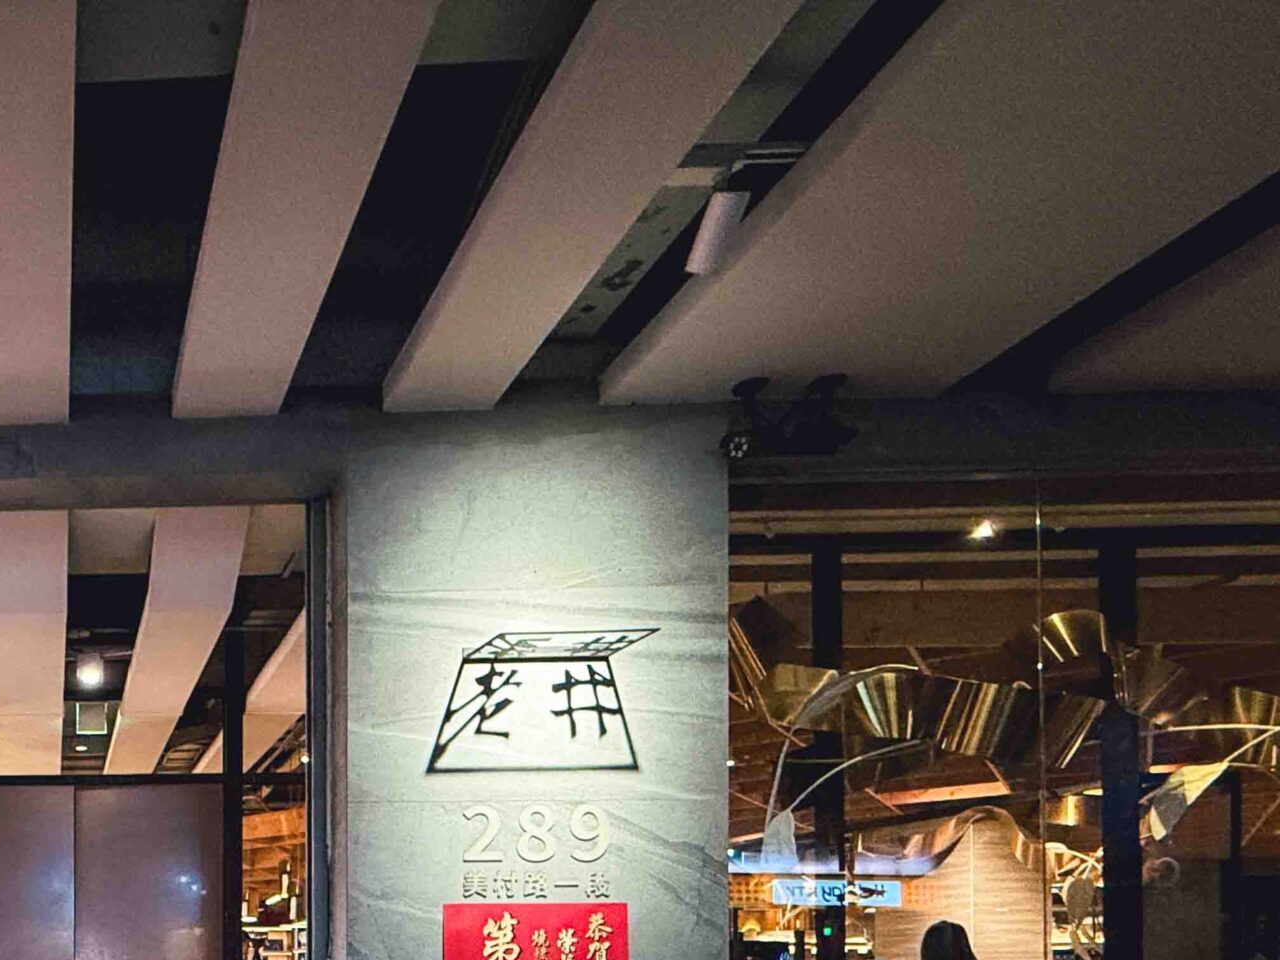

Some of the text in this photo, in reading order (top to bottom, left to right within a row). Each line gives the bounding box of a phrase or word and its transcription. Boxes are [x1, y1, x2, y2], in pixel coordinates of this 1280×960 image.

[436, 655, 622, 757] 老井
[461, 803, 611, 863] 289
[462, 871, 611, 899] 美村路一段
